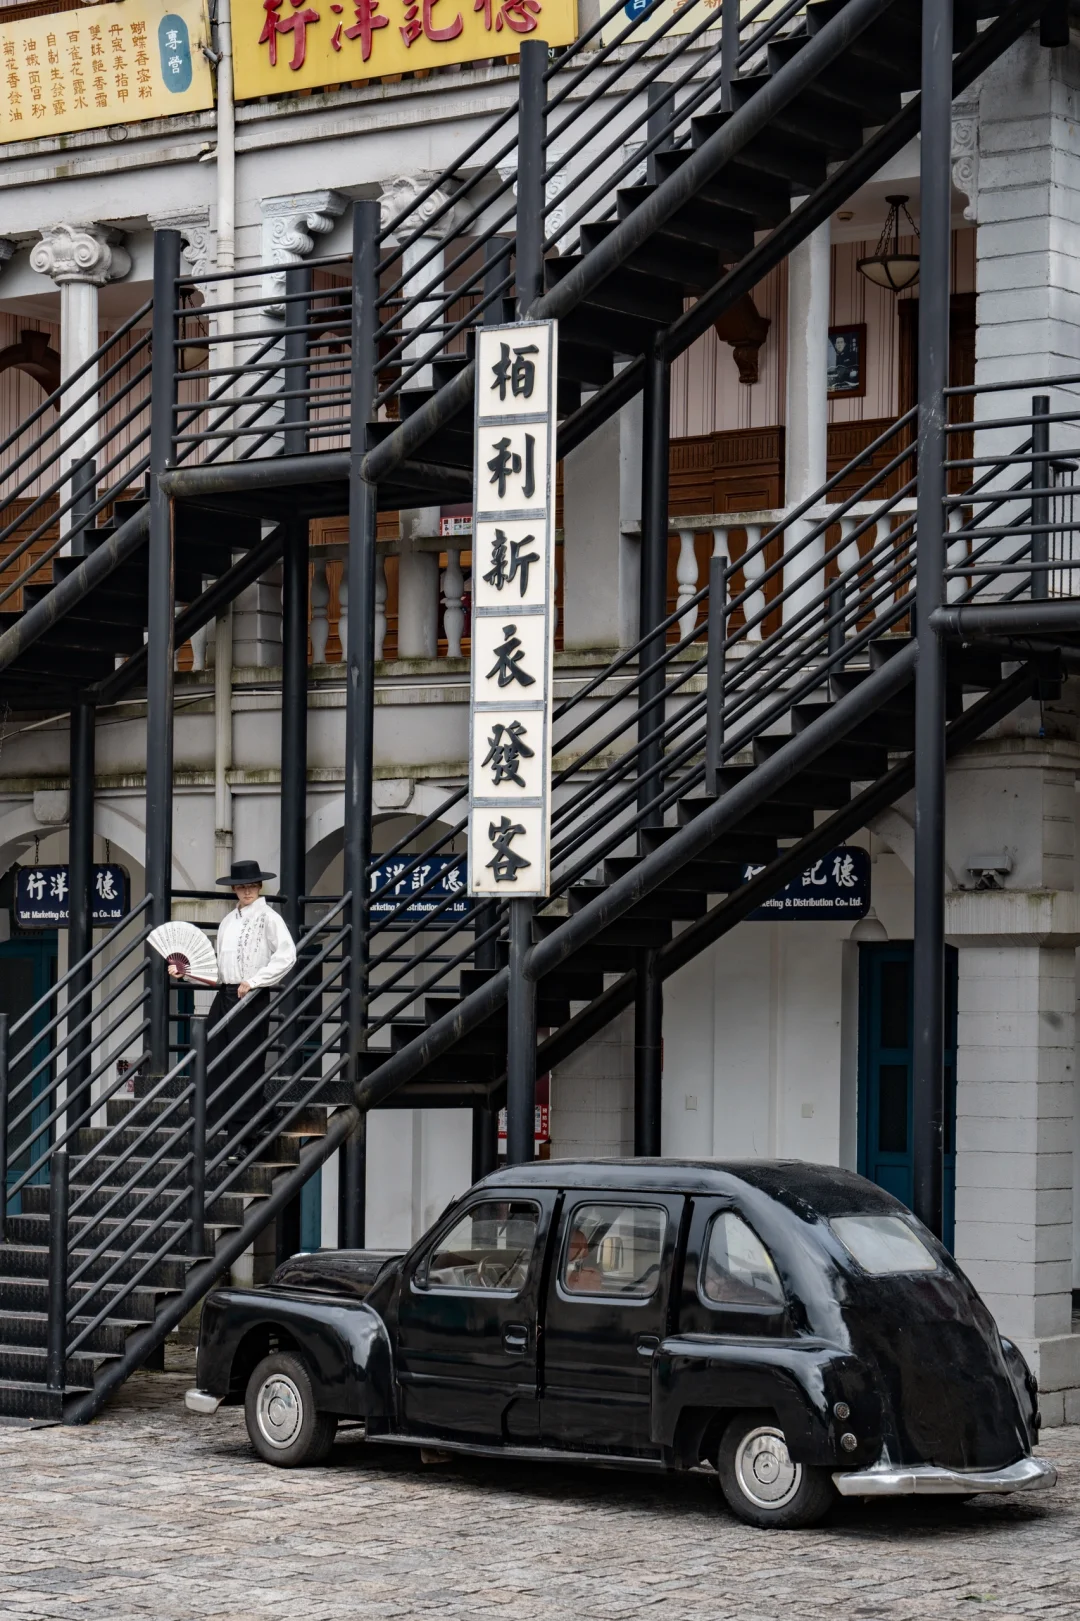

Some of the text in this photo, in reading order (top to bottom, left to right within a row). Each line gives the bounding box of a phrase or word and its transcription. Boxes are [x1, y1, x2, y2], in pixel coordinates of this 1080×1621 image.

[66, 30, 88, 109] 百雀花露水
[785, 898, 792, 907] &
[793, 898, 833, 907] Distribution
[850, 897, 862, 906] Ltd.
[31, 910, 59, 920] Marketing
[59, 910, 65, 918] &
